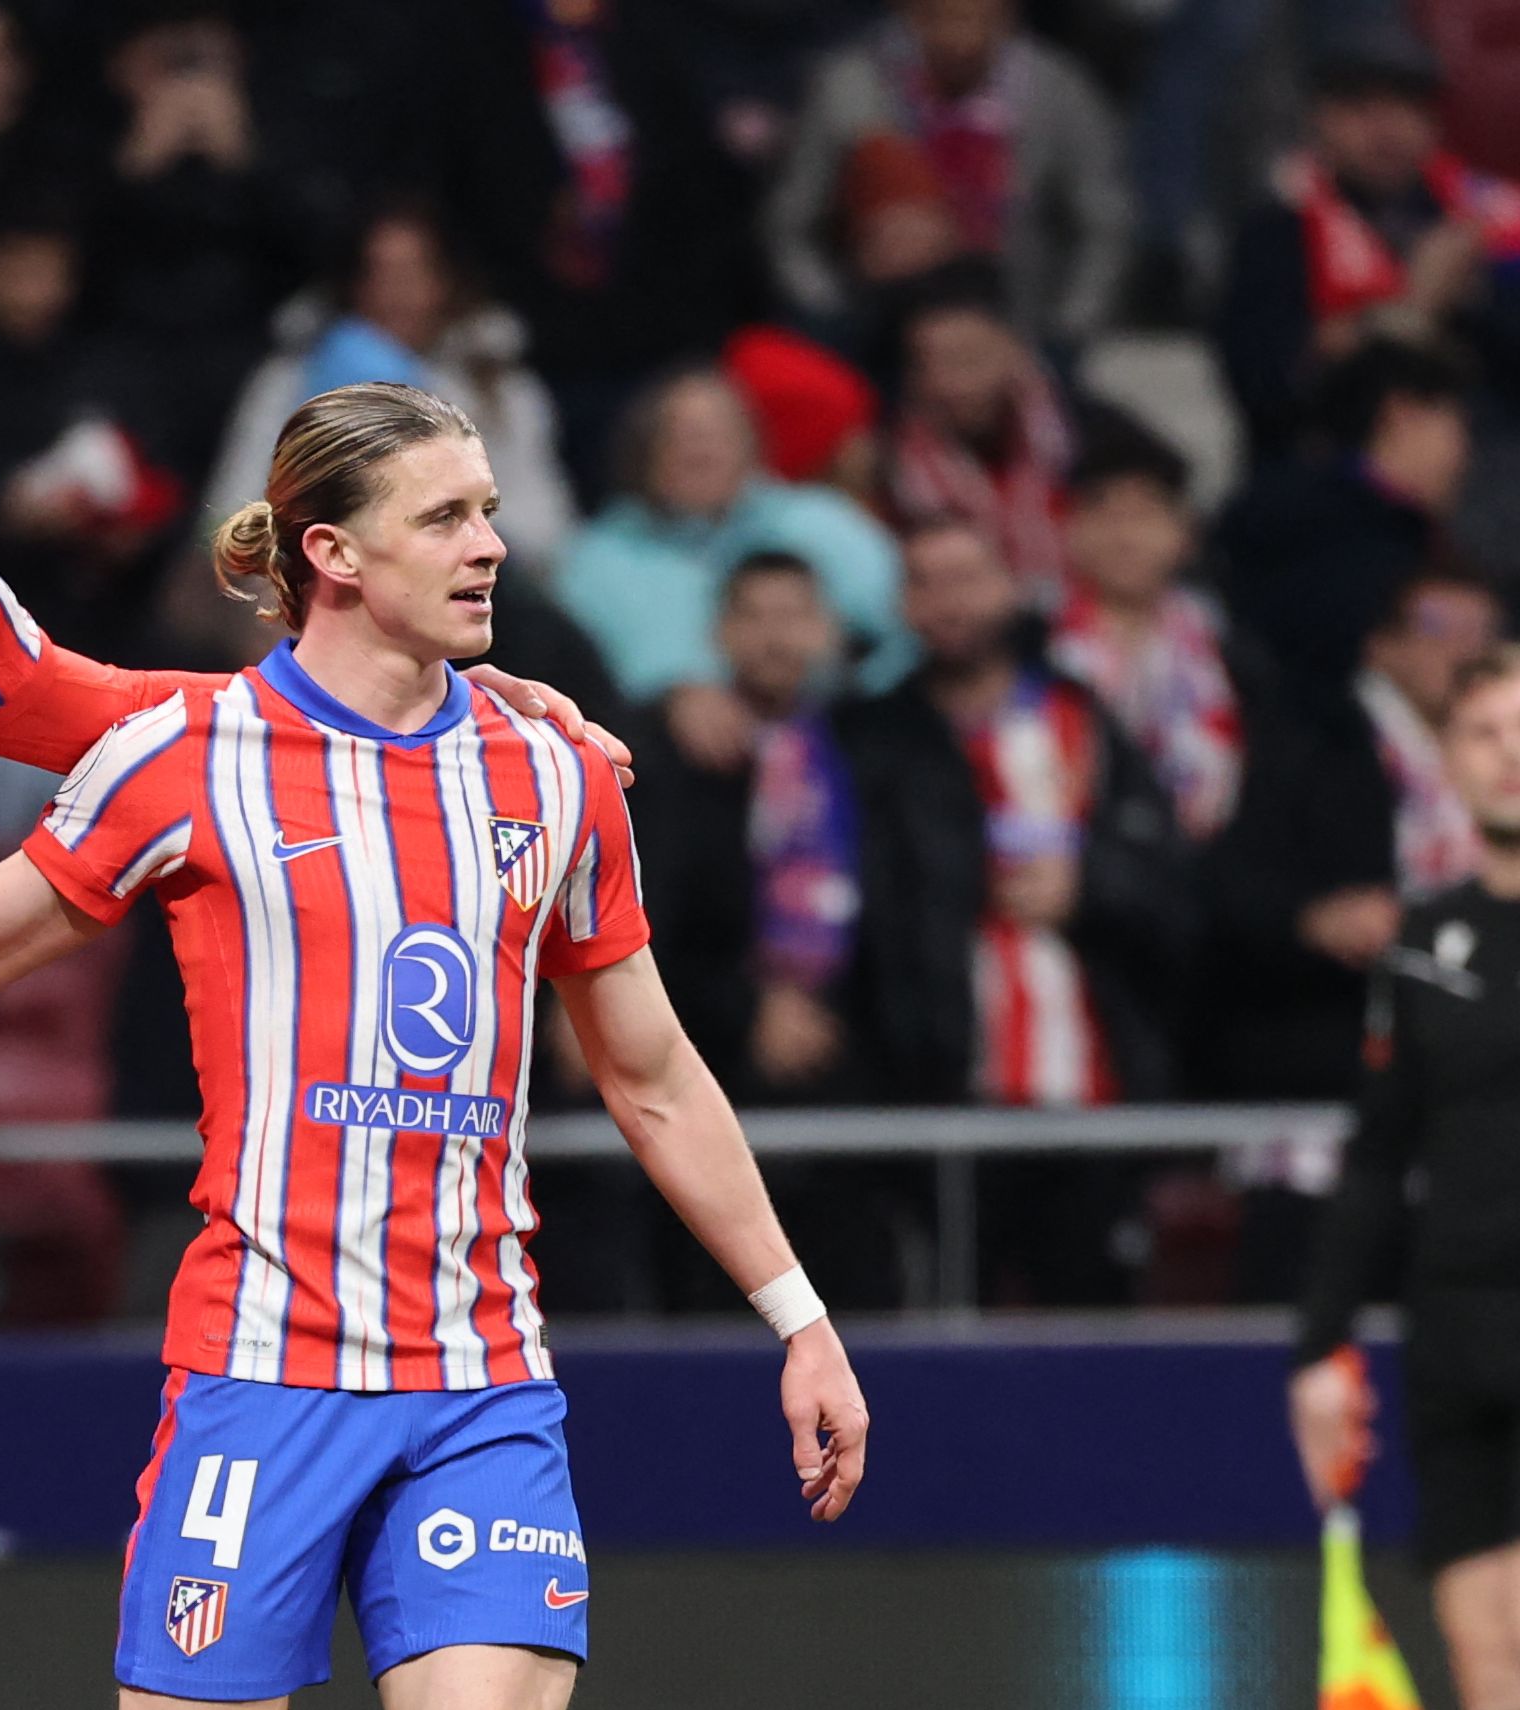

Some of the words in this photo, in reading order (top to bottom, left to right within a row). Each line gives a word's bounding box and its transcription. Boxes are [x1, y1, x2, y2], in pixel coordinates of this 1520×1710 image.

[314, 1087, 450, 1130] RIYADH
[459, 1101, 500, 1134] AIR
[181, 1454, 258, 1569] 4
